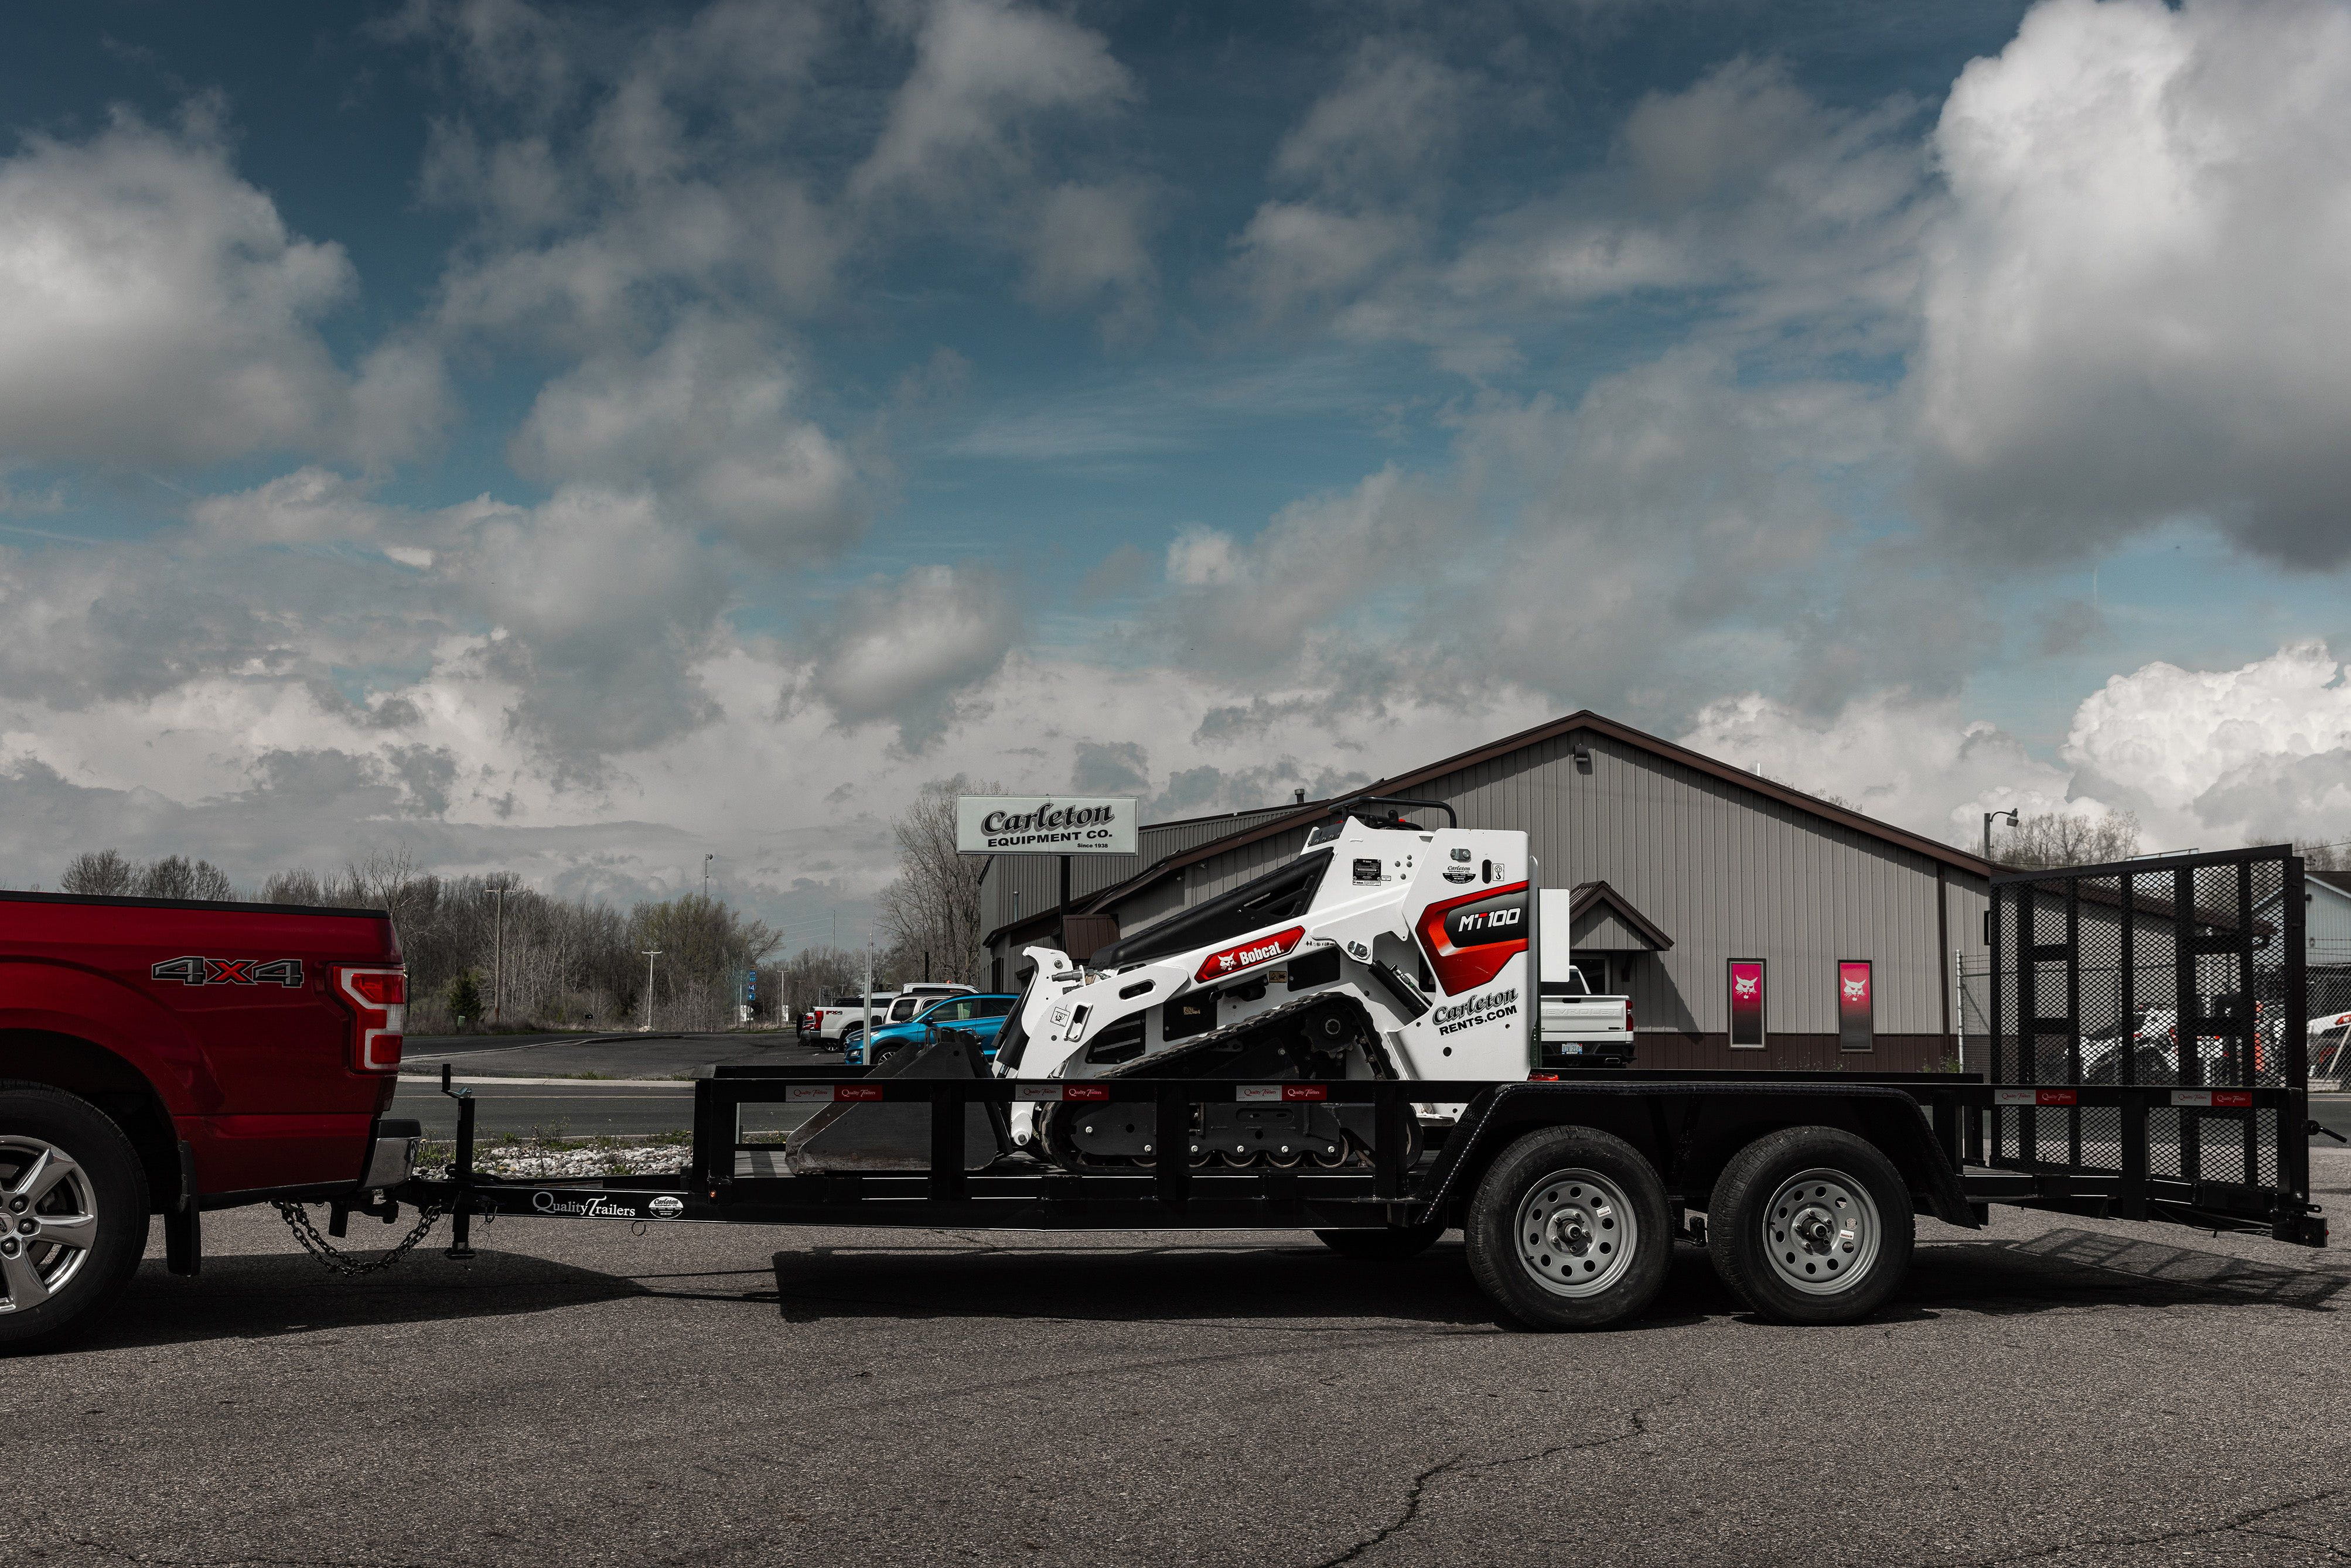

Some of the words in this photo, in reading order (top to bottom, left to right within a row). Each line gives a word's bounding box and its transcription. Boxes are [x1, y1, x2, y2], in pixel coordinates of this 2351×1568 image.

[981, 802, 1115, 836] Carleton
[988, 832, 1081, 848] EQUIPMENT
[1086, 829, 1113, 839] CO.
[1458, 907, 1521, 932] MT100
[1239, 941, 1282, 966] Bobcat
[1432, 988, 1519, 1026] Carleton
[1439, 1005, 1517, 1036] RENTS.COM
[841, 1089, 859, 1097] Quality
[1069, 1088, 1086, 1096] Quality
[1288, 1088, 1304, 1096] Quality
[533, 1191, 588, 1215] Quality
[586, 1195, 636, 1217] Trailers
